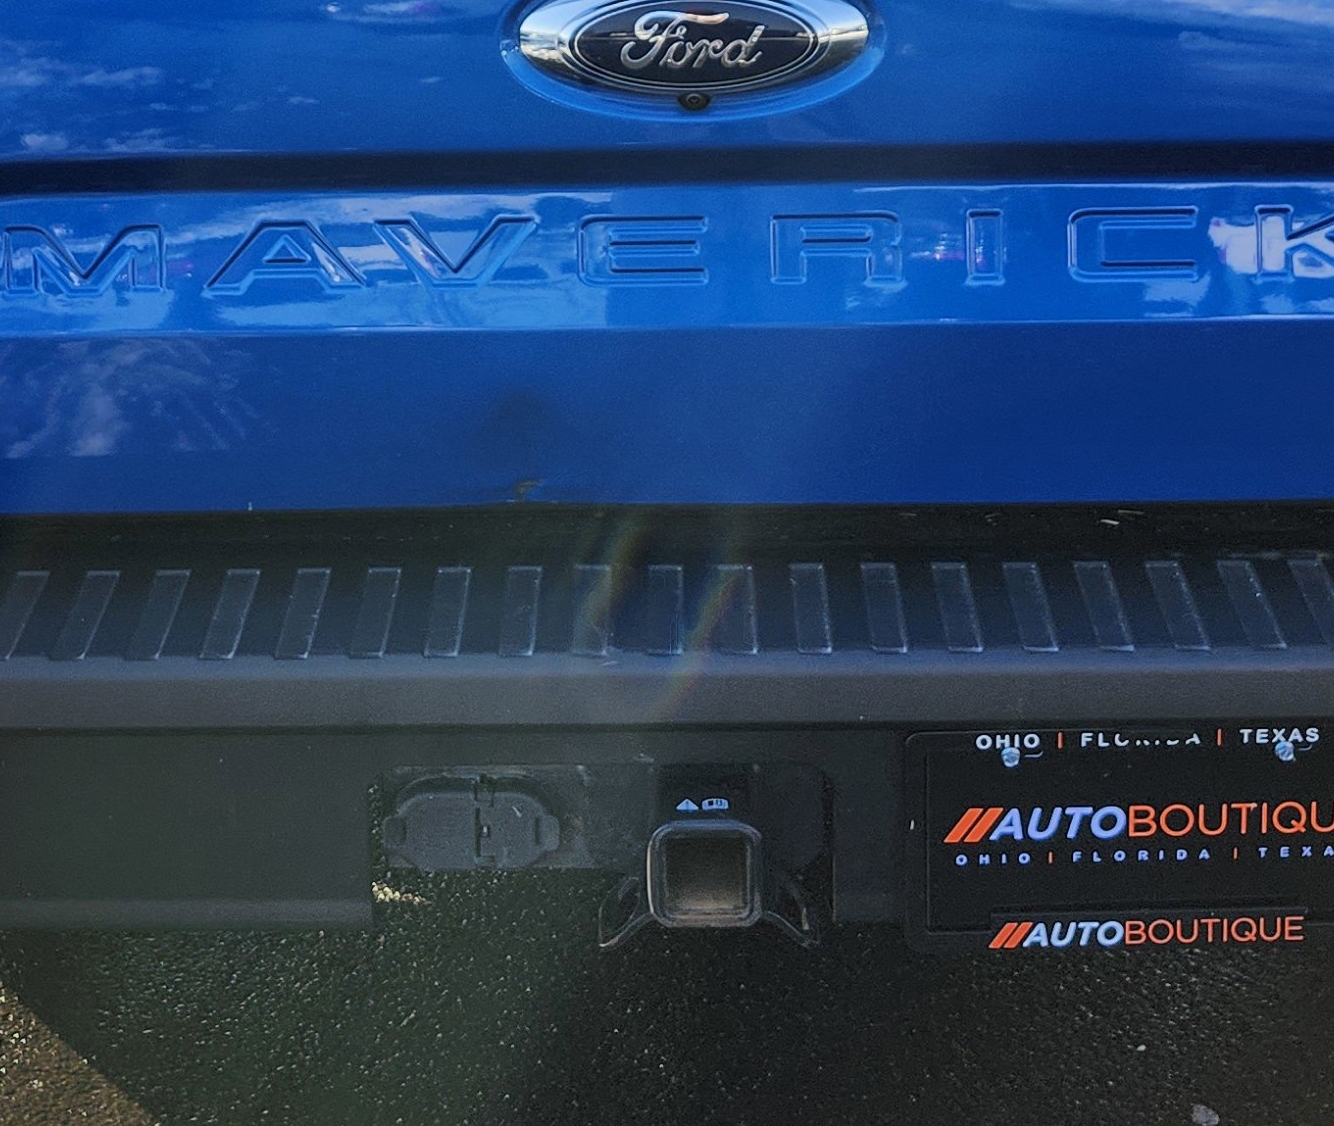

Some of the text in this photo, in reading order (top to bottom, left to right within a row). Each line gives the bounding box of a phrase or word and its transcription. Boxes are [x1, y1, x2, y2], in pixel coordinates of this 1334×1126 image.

[620, 10, 765, 70] Ford
[975, 733, 1041, 750] OHIO
[1239, 727, 1320, 744] TEXAS
[955, 852, 1031, 867] OHIO
[1072, 848, 1210, 863] FLORIDA
[1022, 915, 1305, 948] AUTOBOUTIQUE
